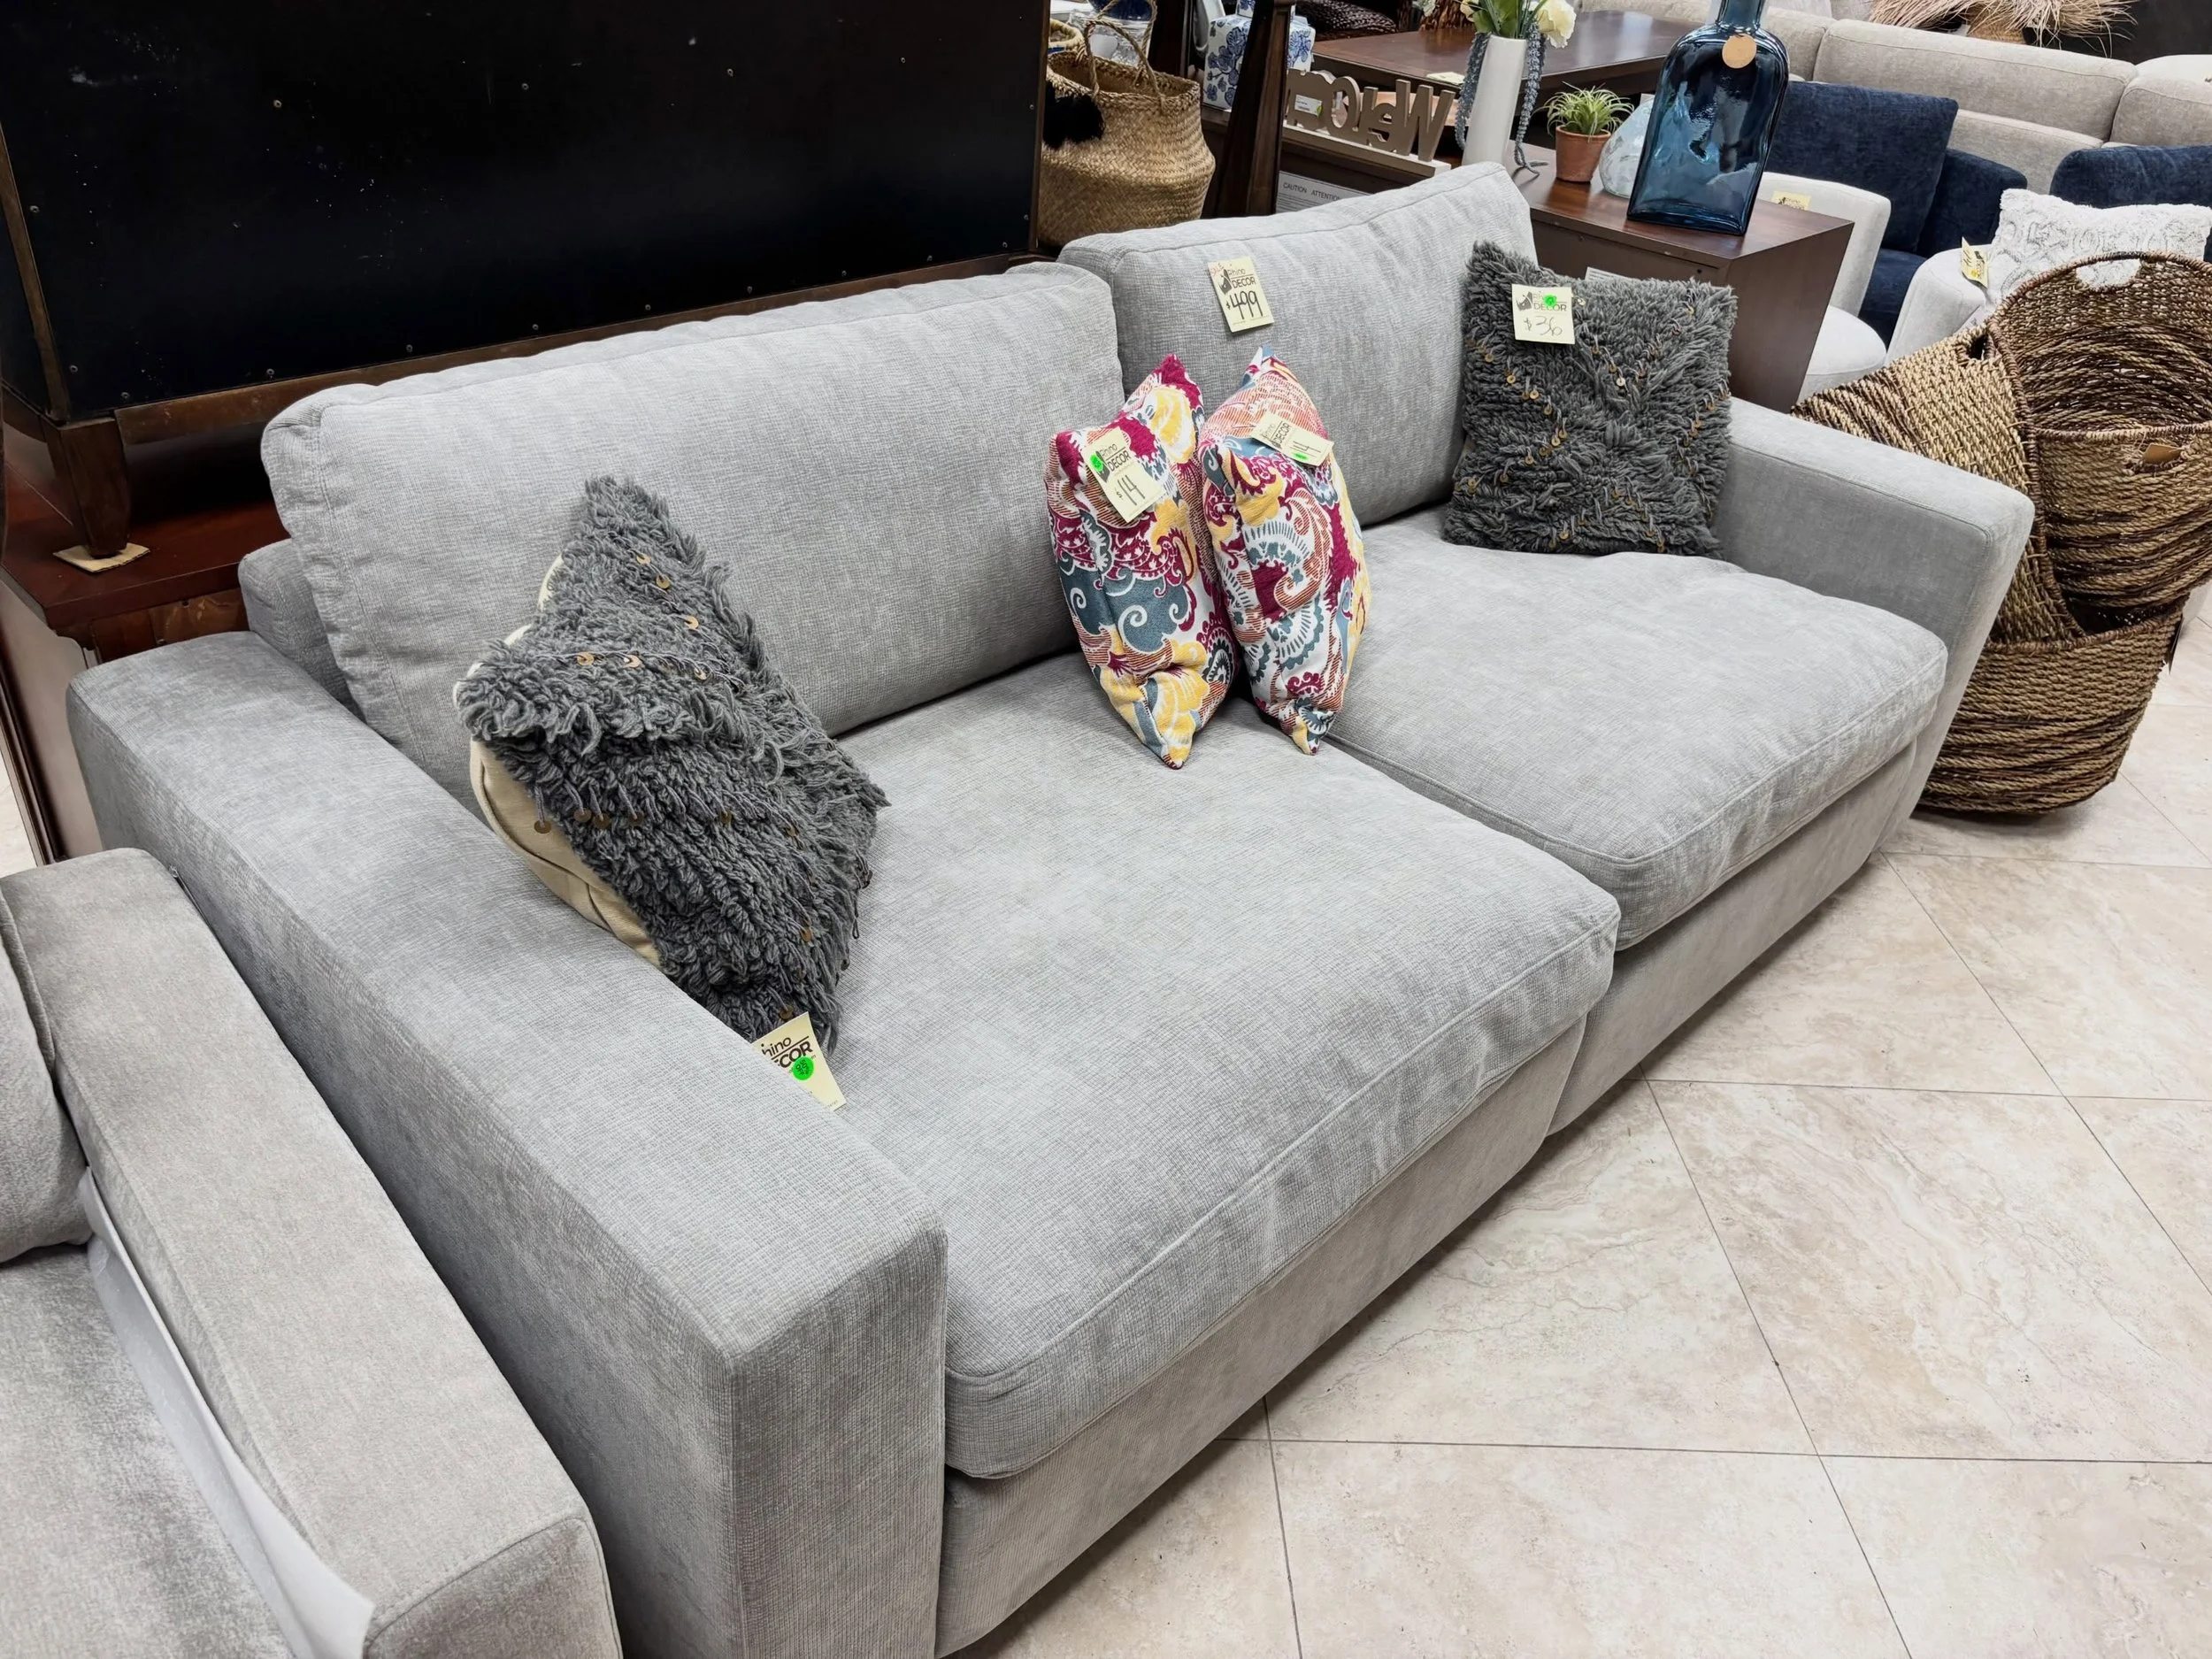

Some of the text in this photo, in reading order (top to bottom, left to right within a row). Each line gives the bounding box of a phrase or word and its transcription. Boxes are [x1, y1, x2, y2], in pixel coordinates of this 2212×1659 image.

[1283, 181, 1307, 194] CAUTION
[1231, 276, 1256, 289] DECOR
[1272, 422, 1291, 444] DECOR
[1107, 449, 1133, 472] DECOR
[761, 1037, 792, 1057] hino
[795, 1064, 805, 1076] OFF
